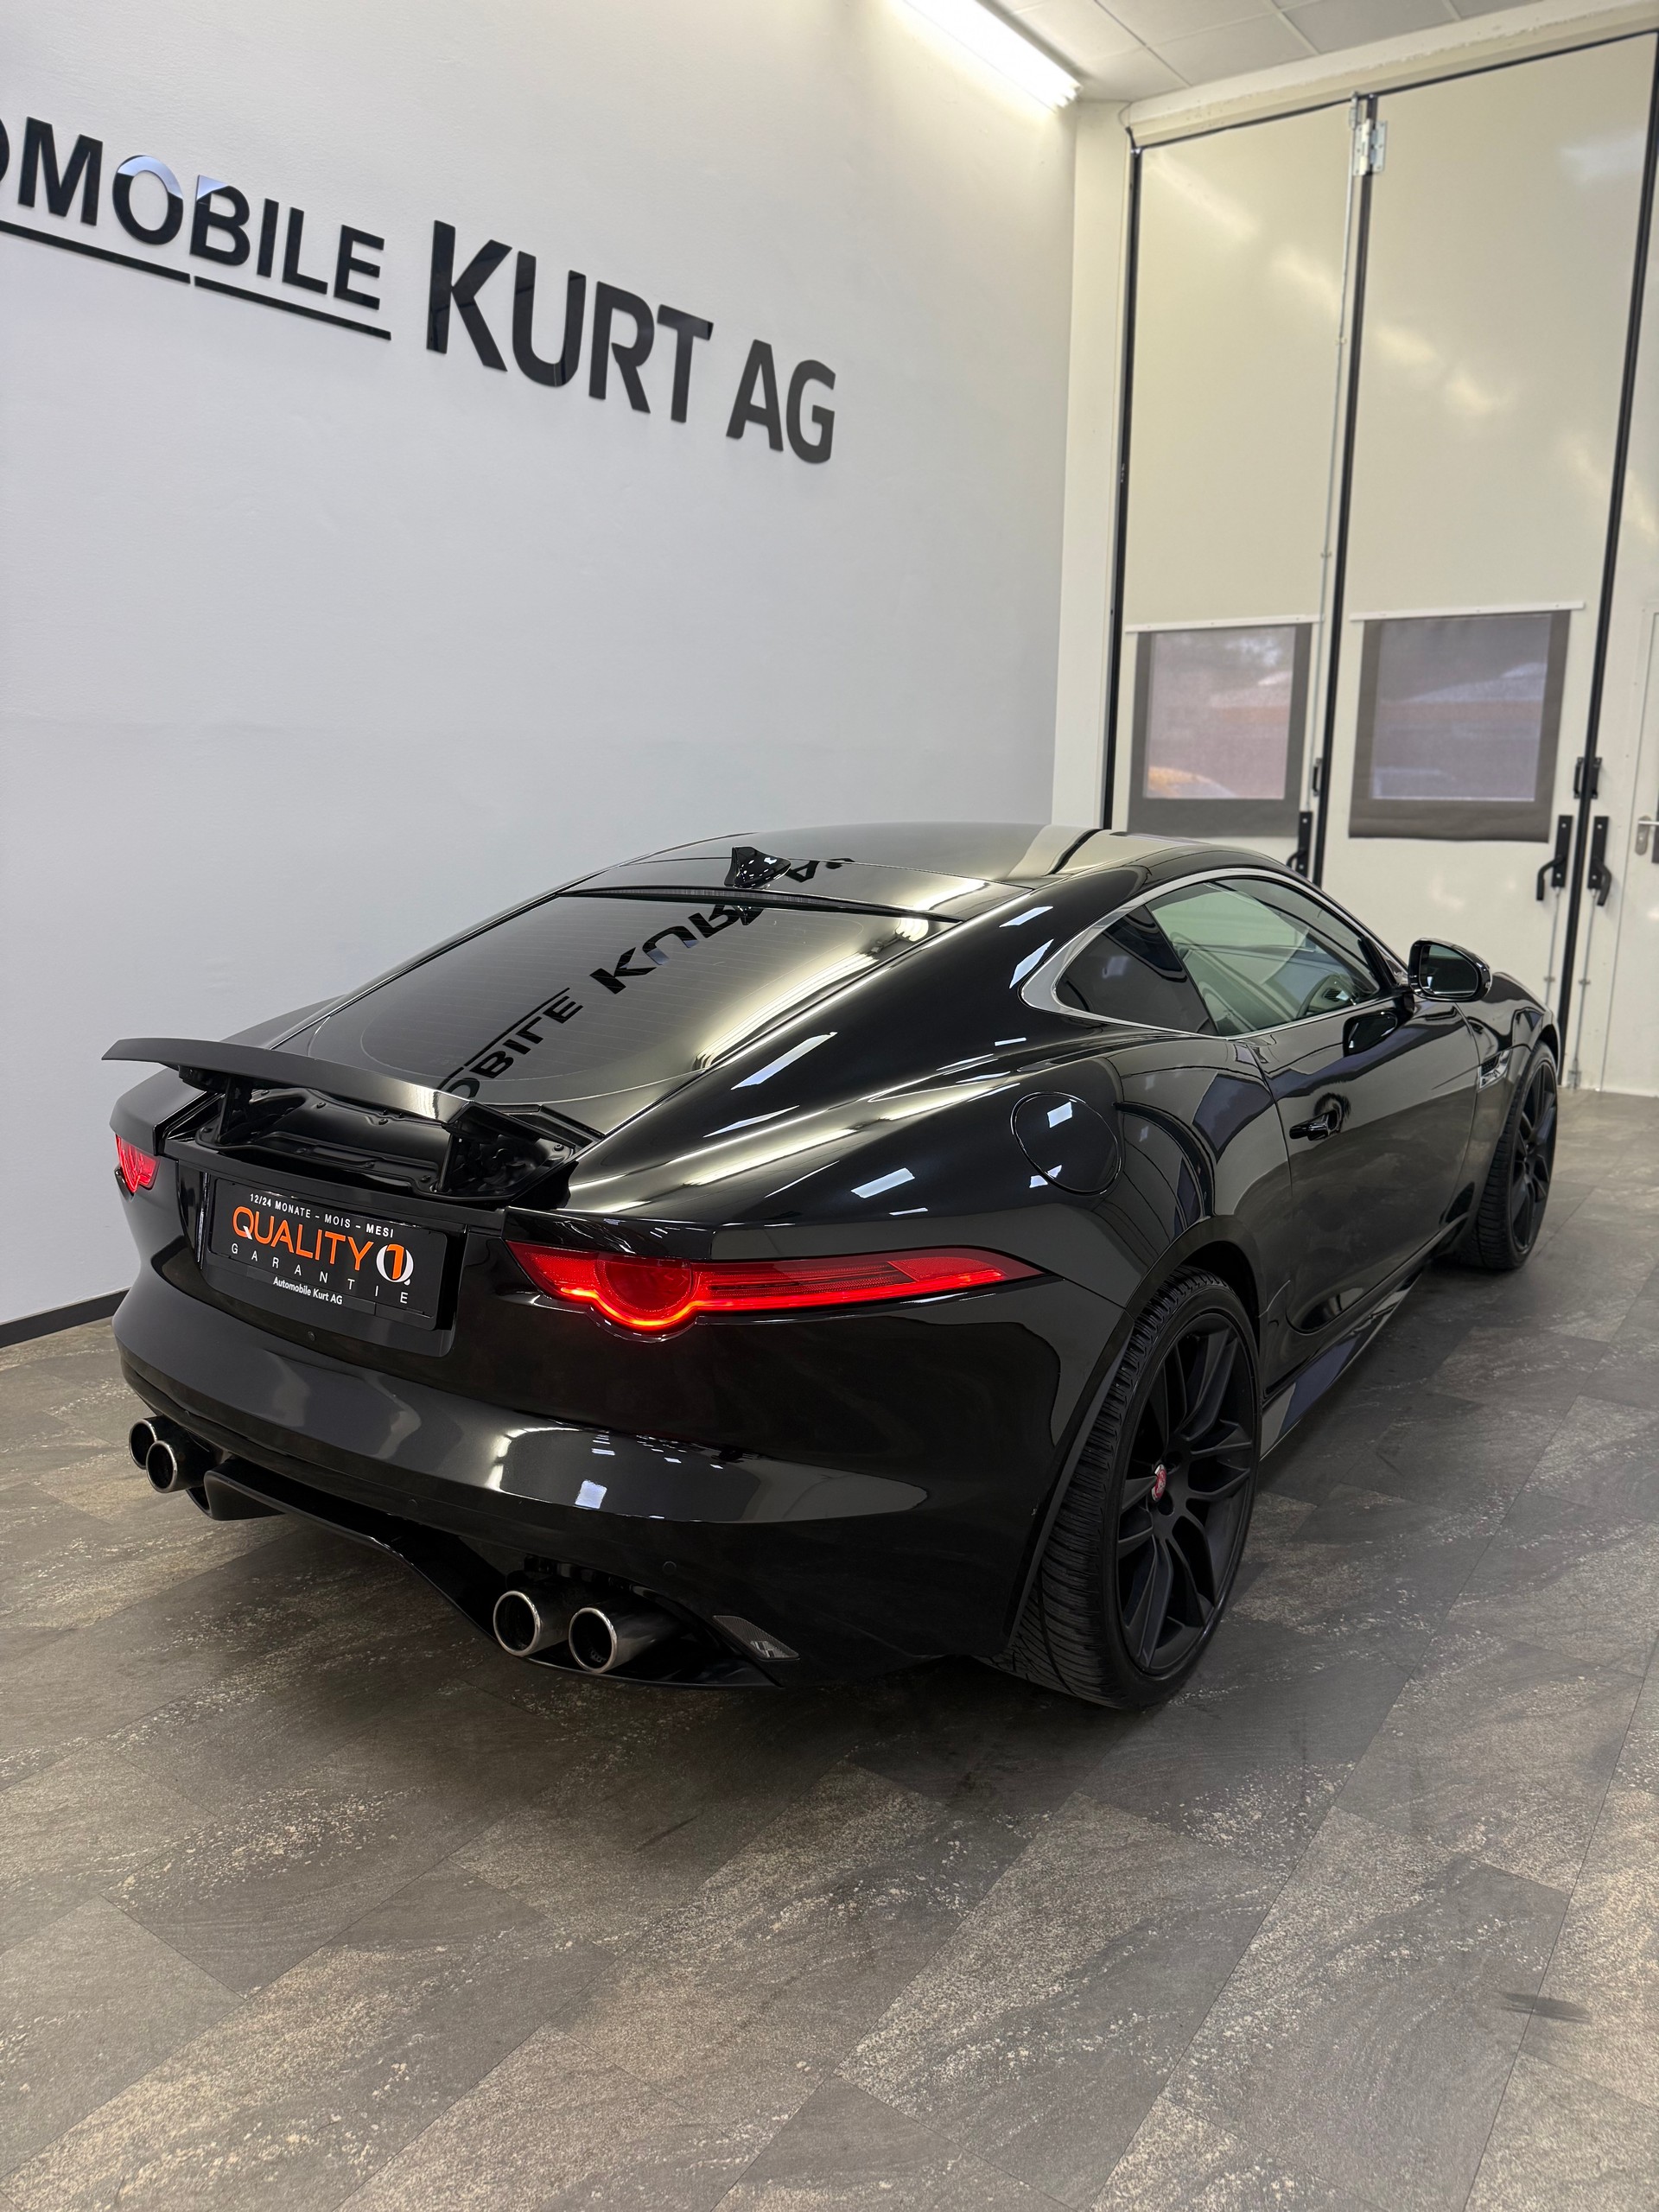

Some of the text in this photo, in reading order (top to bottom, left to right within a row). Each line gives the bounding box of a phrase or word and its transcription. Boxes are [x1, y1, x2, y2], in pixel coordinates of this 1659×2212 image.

[0, 117, 836, 465] MOBILE KURT AG
[232, 1205, 374, 1271] QUALITY
[250, 1193, 272, 1208] 12/24
[275, 1200, 311, 1218] MONATE
[324, 1213, 351, 1229] MOIS
[365, 1223, 394, 1238] MESI
[231, 1243, 409, 1304] GARANTIE
[273, 1276, 343, 1305] Automobile Kurt AG
